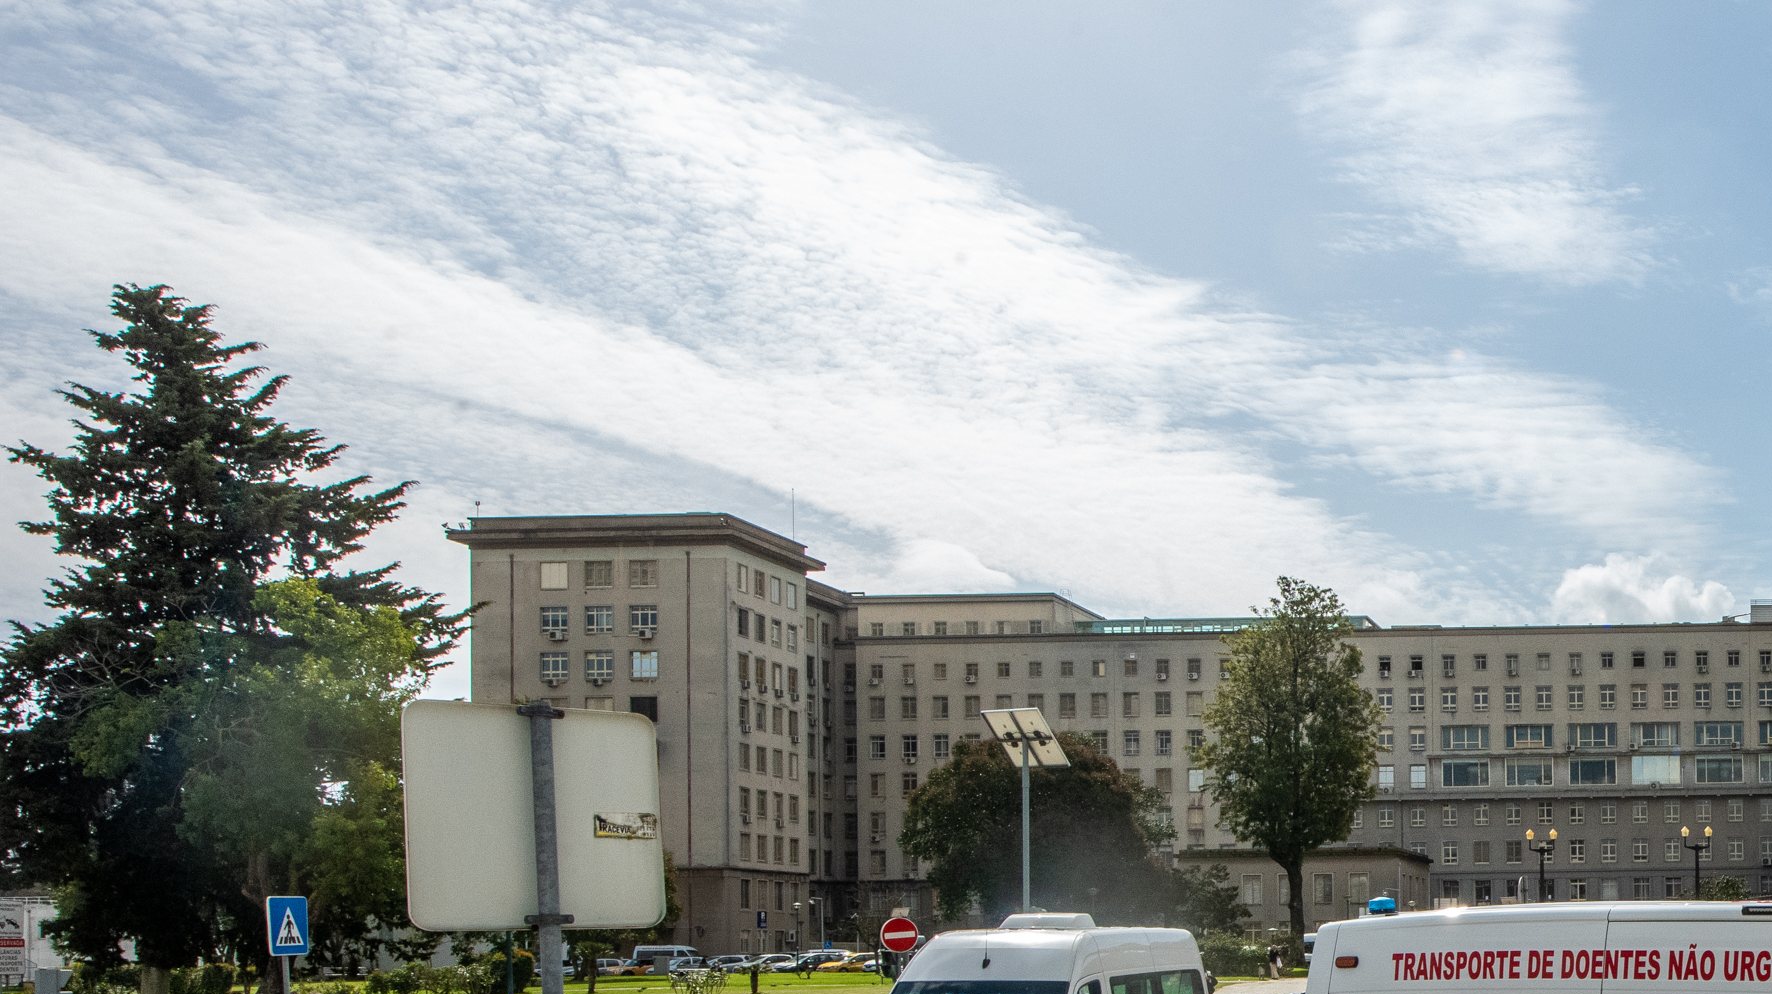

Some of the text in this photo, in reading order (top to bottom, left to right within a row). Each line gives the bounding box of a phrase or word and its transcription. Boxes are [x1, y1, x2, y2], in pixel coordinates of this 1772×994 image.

[1392, 950, 1522, 981] TRANSPORTE
[1527, 950, 1555, 980] DE
[1560, 949, 1661, 981] DOENTES
[1667, 943, 1716, 981] NÃO
